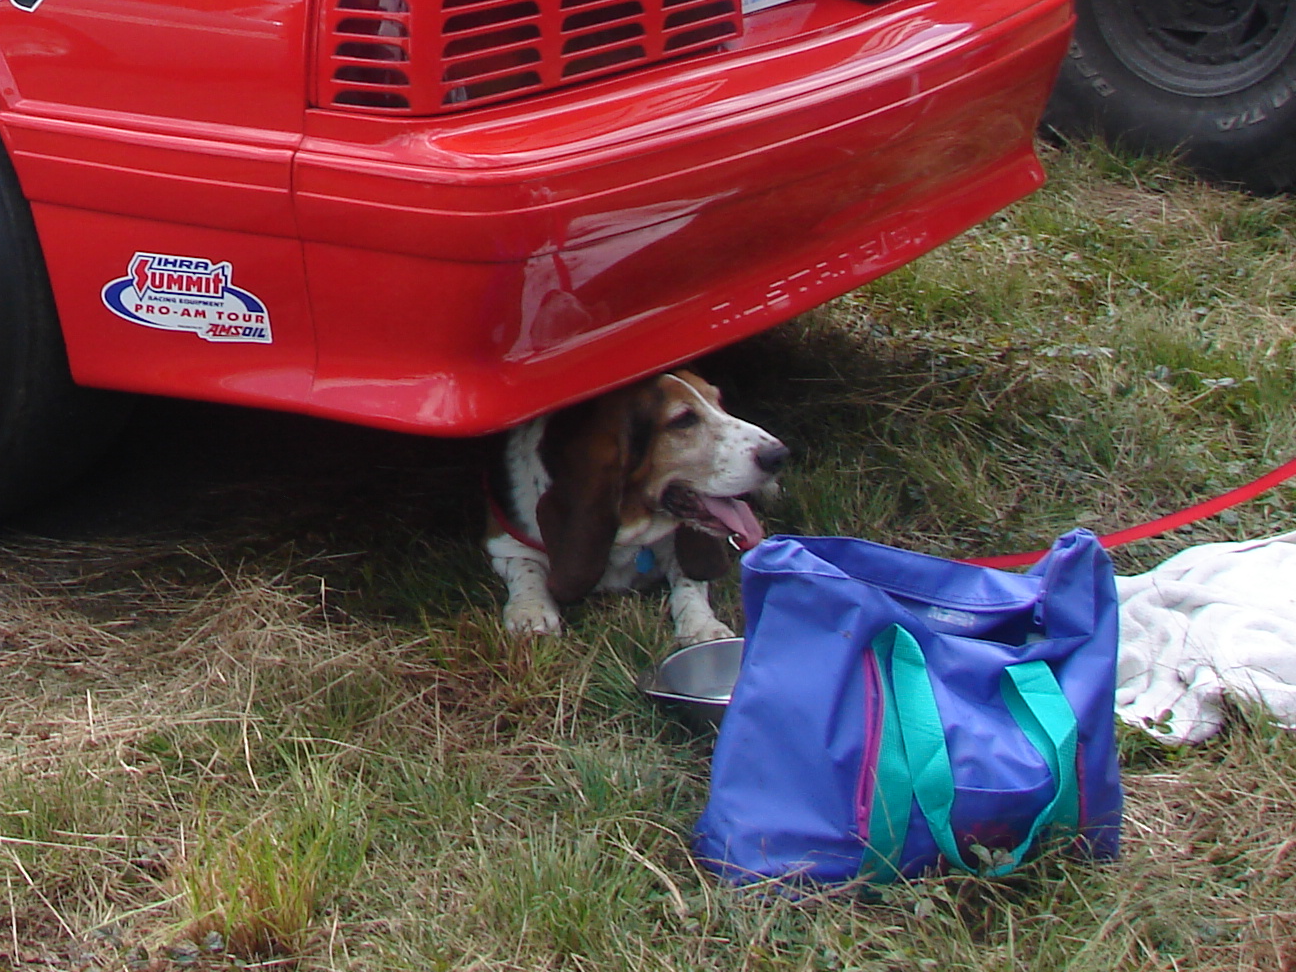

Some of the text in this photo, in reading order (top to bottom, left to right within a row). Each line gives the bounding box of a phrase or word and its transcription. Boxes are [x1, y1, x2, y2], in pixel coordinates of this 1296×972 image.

[157, 257, 210, 271] IHRA
[148, 295, 225, 308] RACING EQUIPMENT
[134, 303, 265, 324] PRO-AM TOUR
[206, 323, 267, 338] AMSOIL
